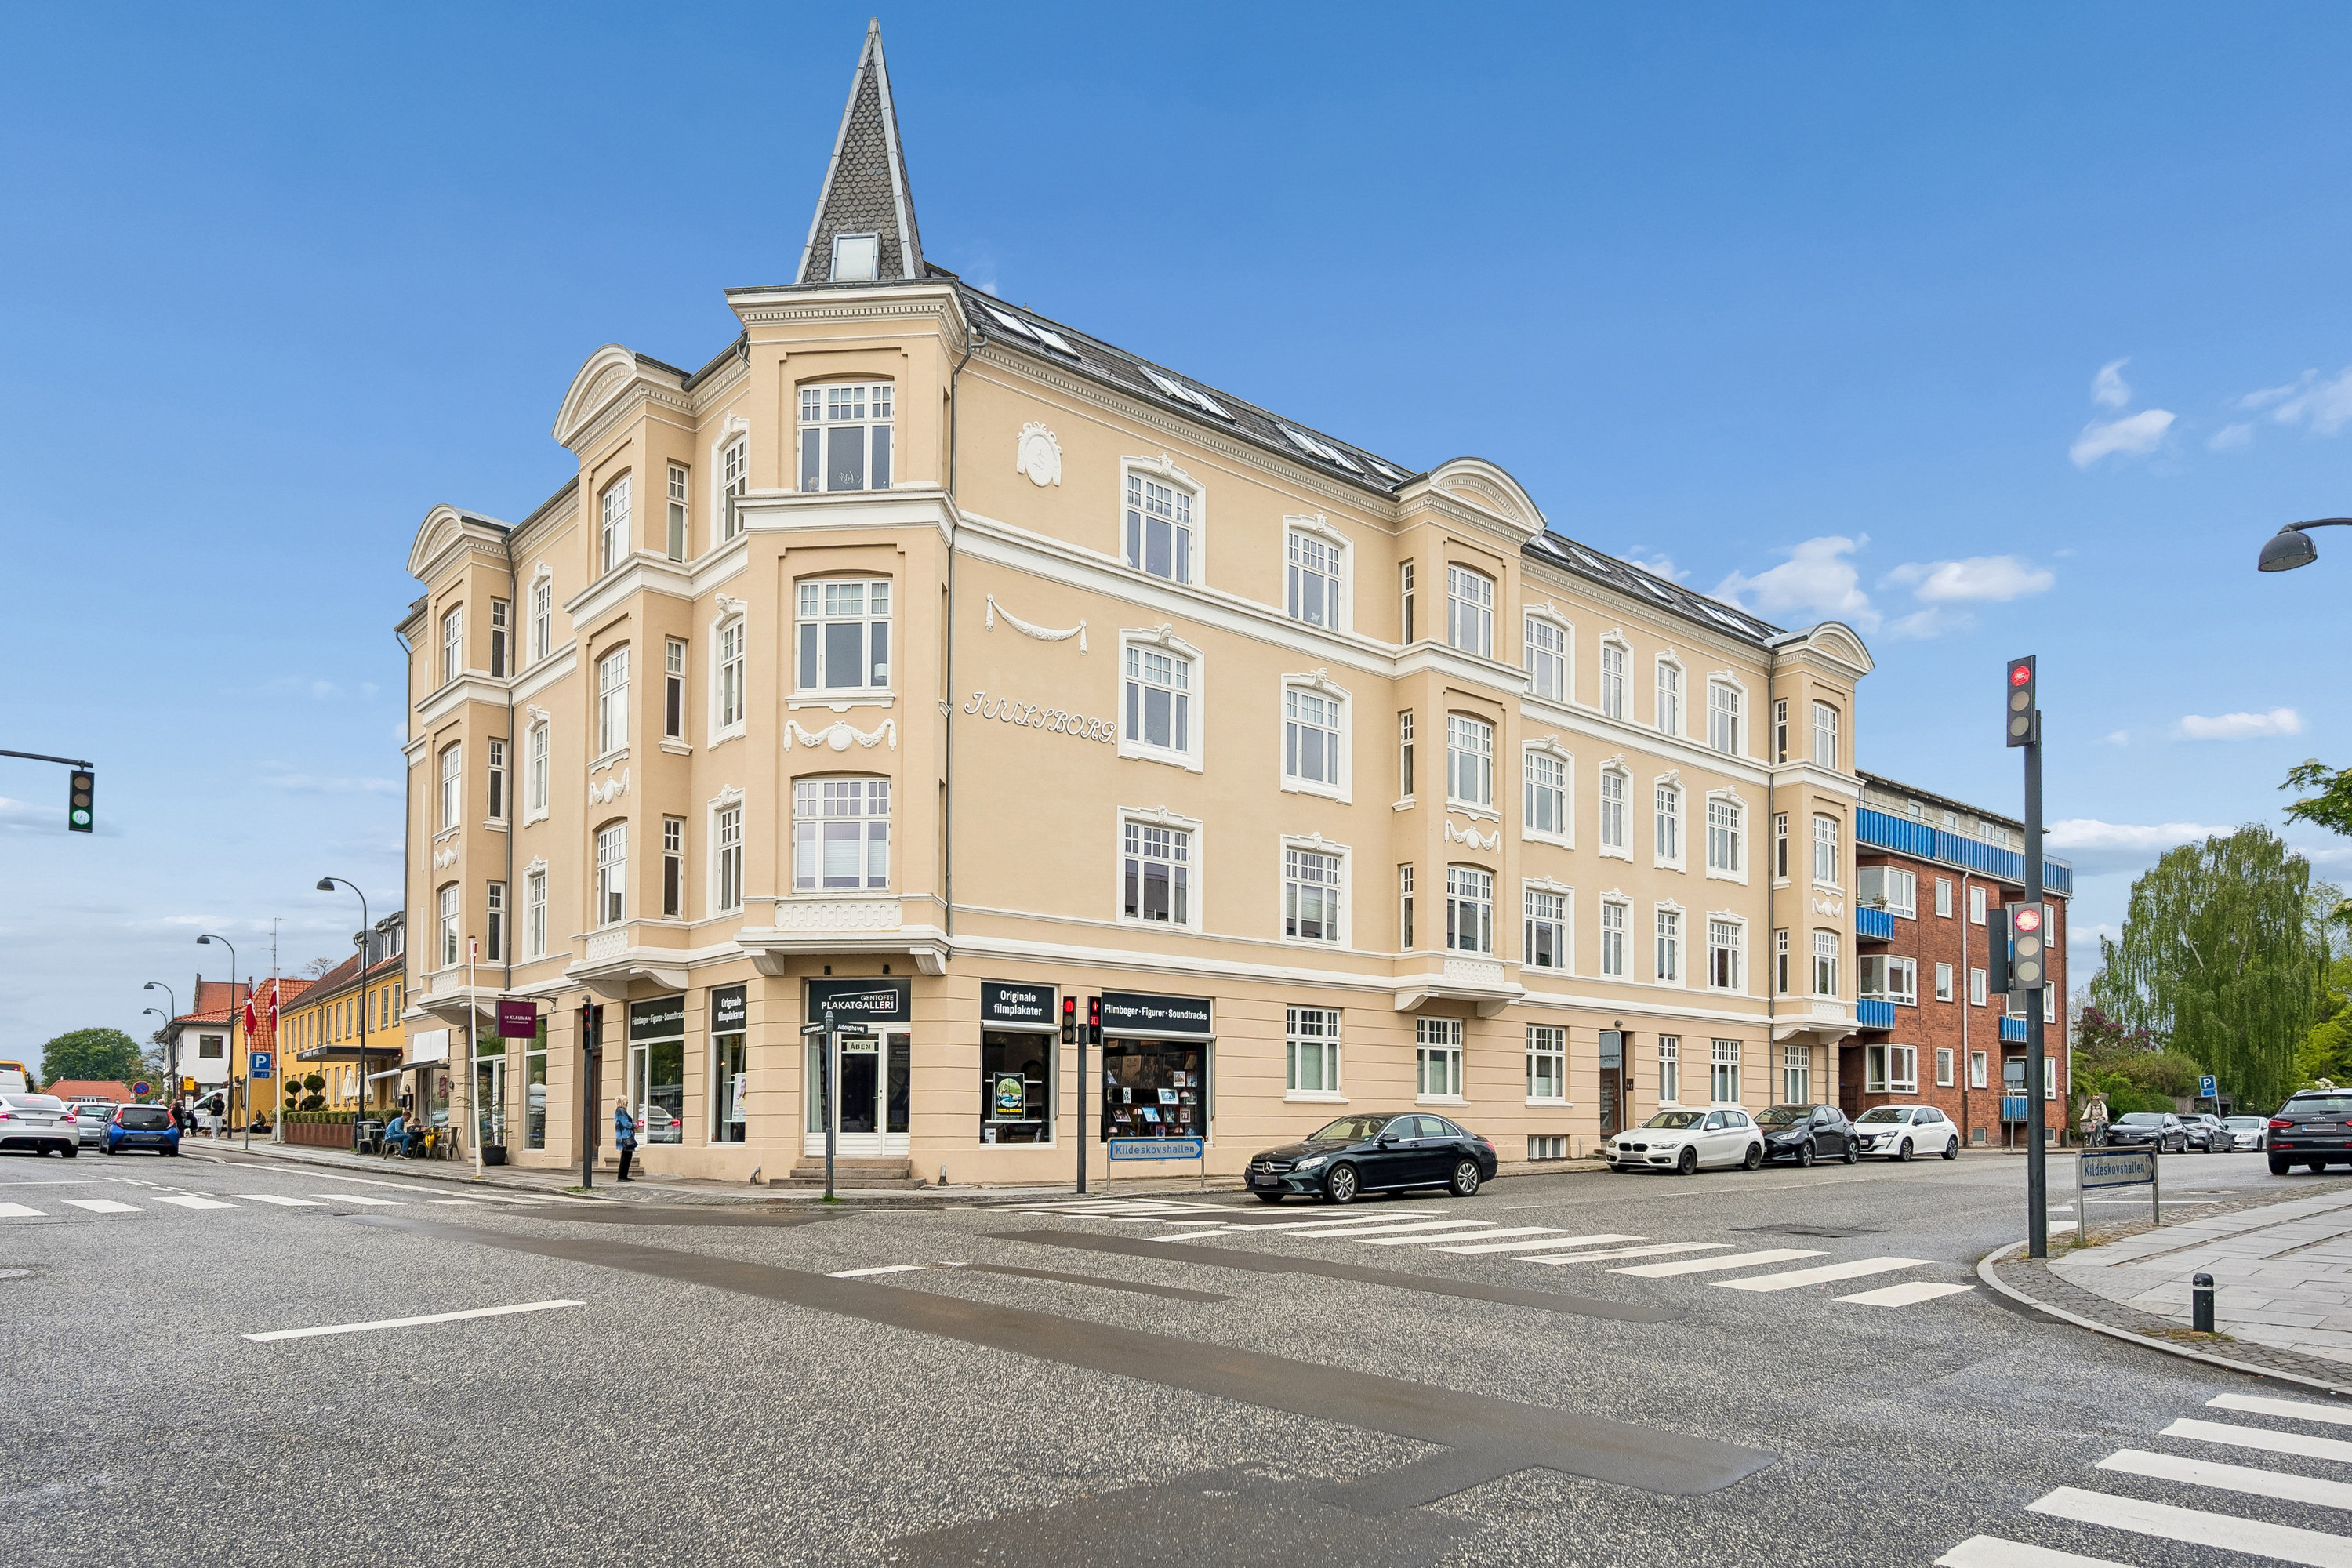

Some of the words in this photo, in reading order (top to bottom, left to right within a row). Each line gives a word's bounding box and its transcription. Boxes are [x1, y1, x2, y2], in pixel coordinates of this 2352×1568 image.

[721, 996, 742, 1010] Originale
[1000, 990, 1036, 1004] Originale
[821, 1001, 894, 1010] PLAKATGALLERI
[993, 1004, 1043, 1017] filmplakater
[717, 1011, 746, 1022] filmplakater
[1142, 1007, 1165, 1018] Figurer
[1168, 1008, 1207, 1021] Soundtracks
[837, 1024, 865, 1033] Adolphsvej
[256, 1055, 267, 1067] P
[2203, 1078, 2212, 1088] P
[1116, 1145, 1195, 1155] Kildeskovshallen
[2085, 1160, 2145, 1177] Kildeskovshallen
